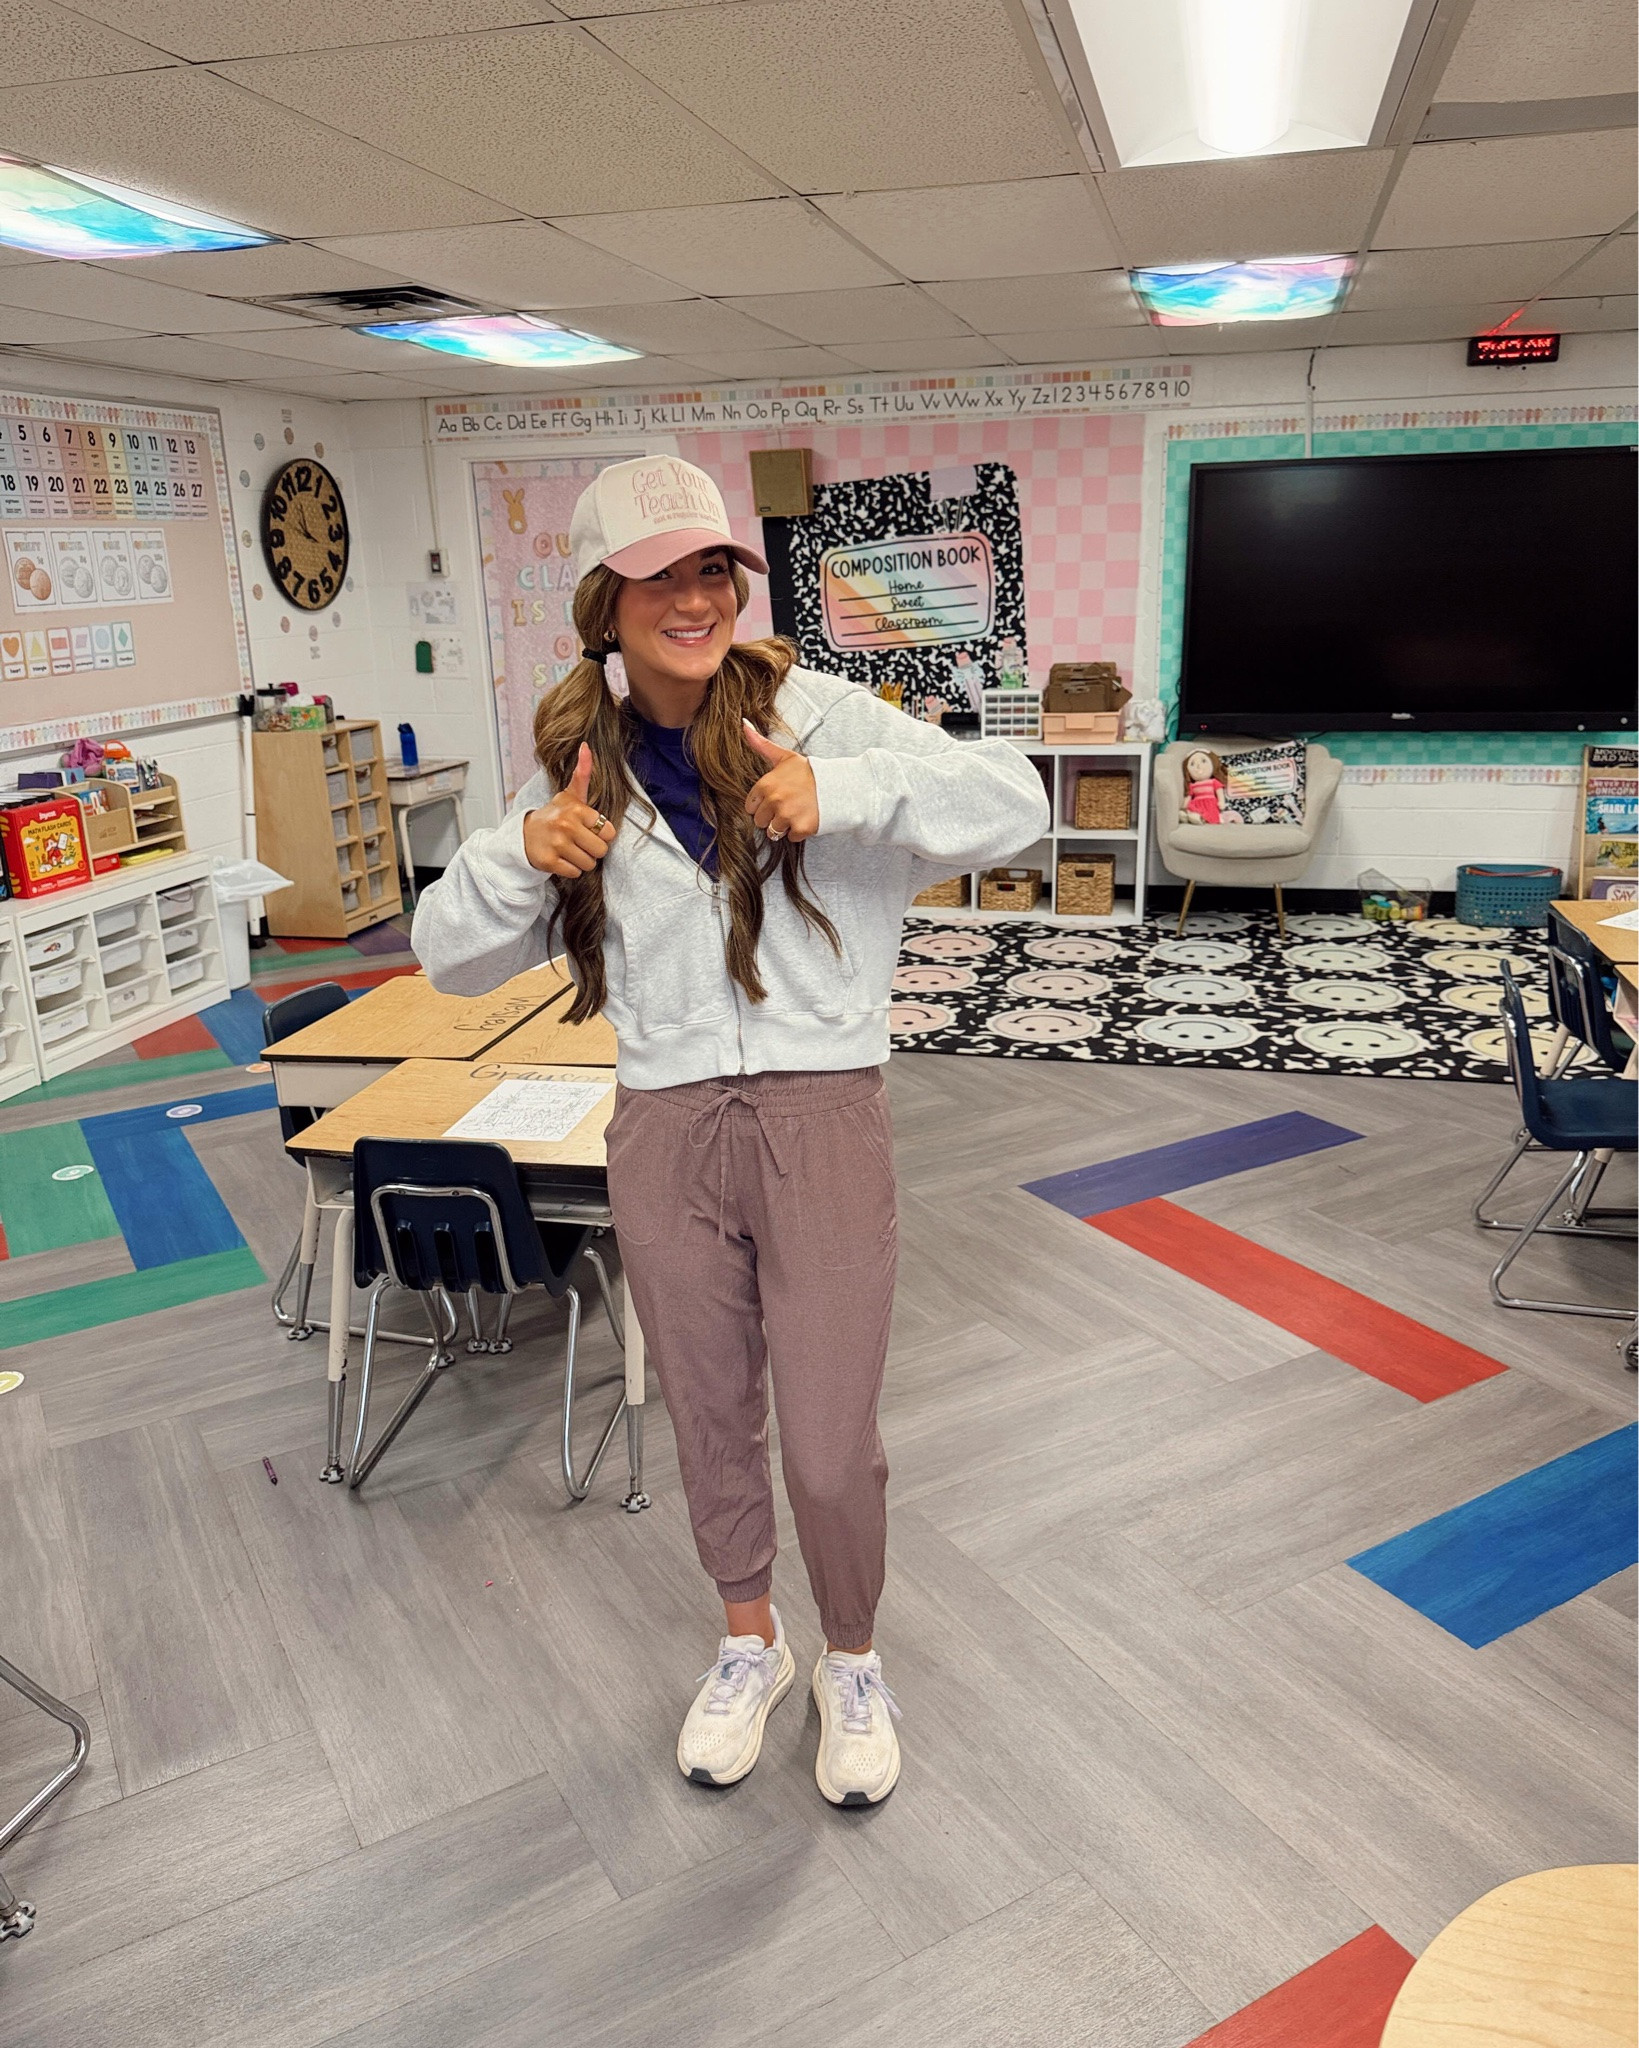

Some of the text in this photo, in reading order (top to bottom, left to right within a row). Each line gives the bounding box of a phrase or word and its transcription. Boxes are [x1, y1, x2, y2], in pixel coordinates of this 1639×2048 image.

[438, 418, 457, 433] Aa
[462, 416, 480, 432] Bb
[483, 416, 503, 431] Cc
[507, 414, 526, 430] Dd
[530, 413, 548, 429] Ee
[551, 411, 567, 428] Ff
[570, 411, 592, 433] Gg
[595, 410, 614, 426] Hh
[618, 409, 628, 426] Ii
[634, 409, 646, 430] Jj
[651, 407, 668, 425] Kk
[671, 405, 685, 423] Ll
[691, 406, 715, 422] Mm
[722, 405, 741, 420] Nn
[746, 403, 768, 419] Oo
[772, 402, 790, 424] Pp
[794, 401, 821, 422] Qq
[823, 399, 842, 416] Rr
[847, 399, 864, 414] Ss
[869, 396, 889, 413] Tt
[894, 395, 914, 412] Uu
[920, 393, 939, 410] Vv
[943, 392, 980, 408] Ww
[984, 390, 1004, 407] Xx
[1008, 389, 1026, 412] Yy
[1032, 388, 1050, 405] Zz
[1061, 386, 1072, 403] 2
[1076, 385, 1086, 402] 3
[1089, 384, 1101, 401] 4
[1104, 383, 1115, 400] 5
[1119, 383, 1128, 399] 6
[1132, 382, 1142, 399] 7
[1145, 382, 1154, 399] 8
[1159, 381, 1168, 398] 9
[1174, 380, 1190, 397] 10
[18, 425, 196, 454] 5 6 7 8 9 10 11 12 13
[1, 475, 202, 497] 18 19 20 21 22 23 24 25 26 27
[282, 472, 297, 501] 11
[295, 466, 312, 492] 12
[315, 475, 323, 498] 1
[632, 462, 707, 493] Get Your
[271, 495, 288, 522] 10
[322, 495, 337, 520] 2
[635, 487, 698, 520] Teach
[270, 529, 285, 548] 9
[328, 523, 343, 543] 3
[277, 556, 292, 579] 8
[328, 550, 342, 572] 4
[831, 546, 981, 578] COMPOSITION BOOK
[293, 571, 305, 597] 7
[308, 579, 321, 604] 6
[319, 567, 333, 594] 5
[888, 580, 924, 594] Home
[511, 599, 546, 627] IS
[890, 595, 925, 611] Sweet
[875, 616, 943, 632] Classroom
[1598, 803, 1625, 814] SHARK
[28, 821, 71, 835] MATH FLASH CARDS
